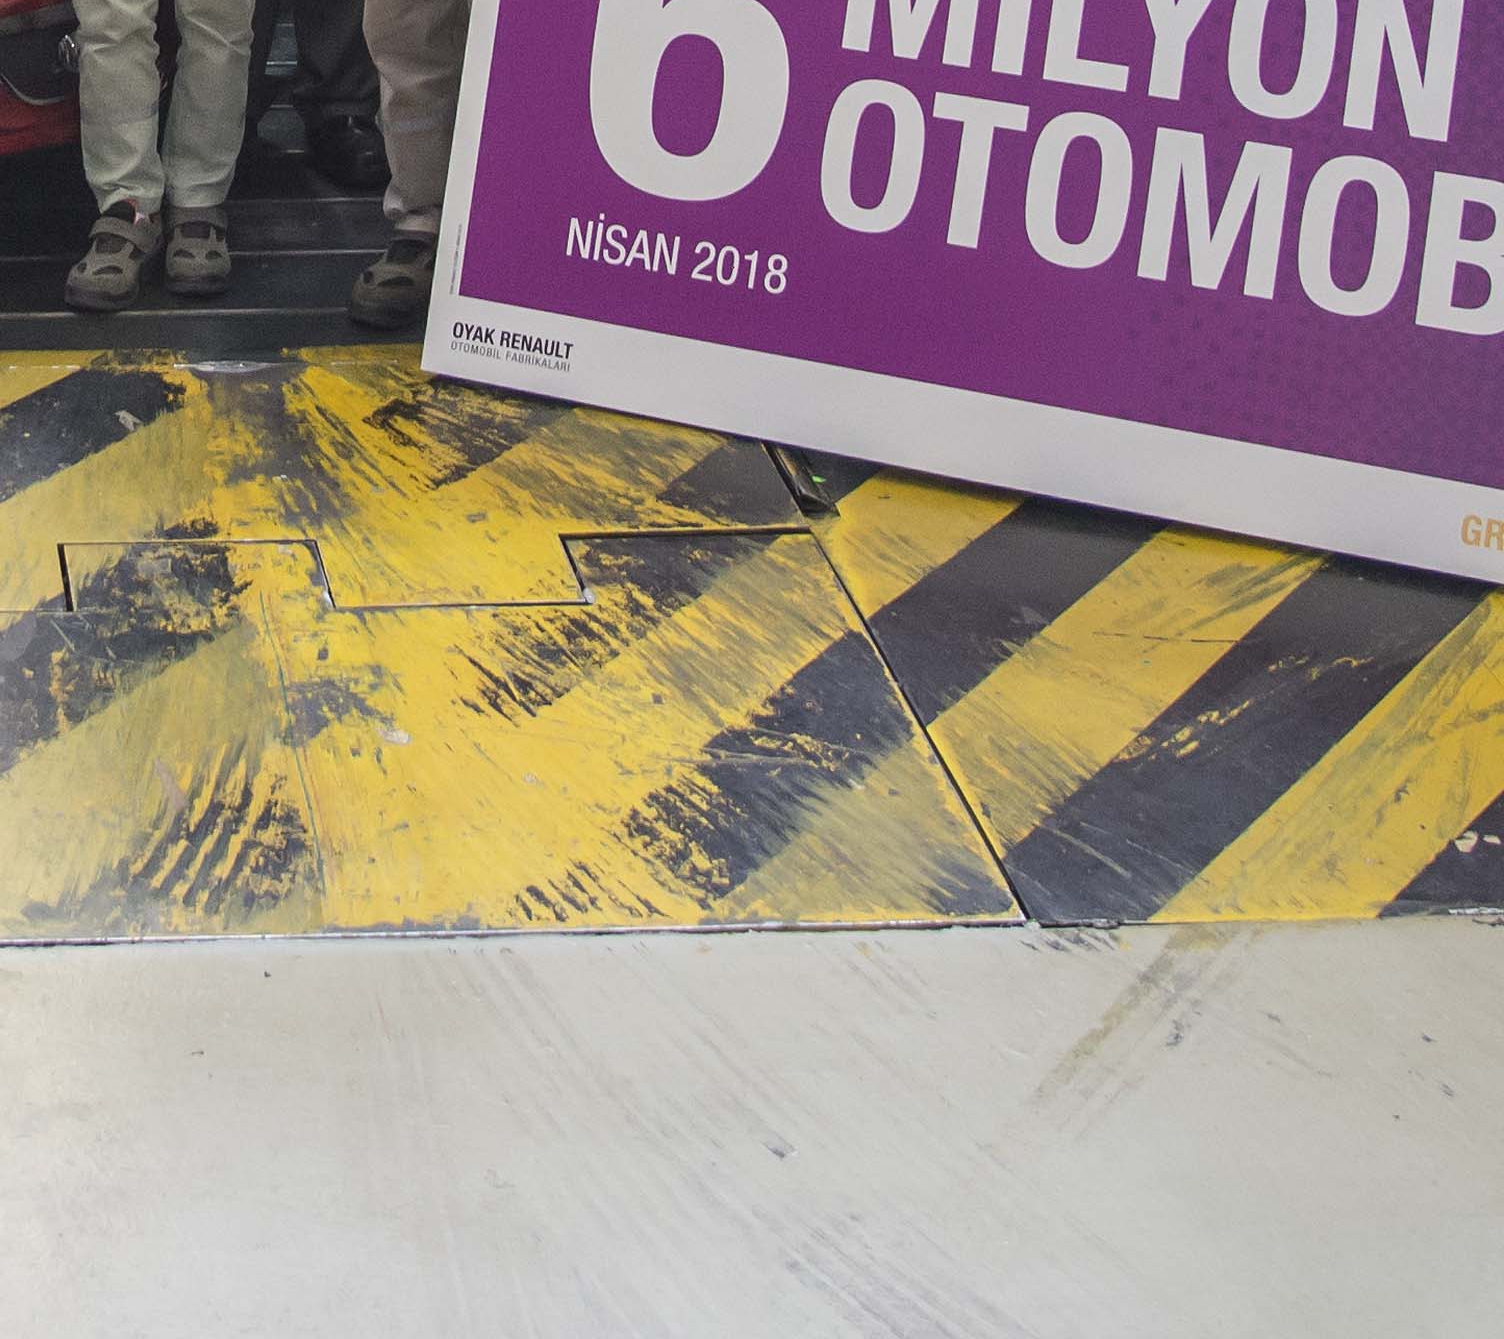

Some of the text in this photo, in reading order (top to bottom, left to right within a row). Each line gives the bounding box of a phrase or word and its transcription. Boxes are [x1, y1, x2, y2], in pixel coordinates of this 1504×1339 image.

[564, 211, 789, 295] NİSAN 2018
[452, 321, 574, 360] OYAK RENAULT
